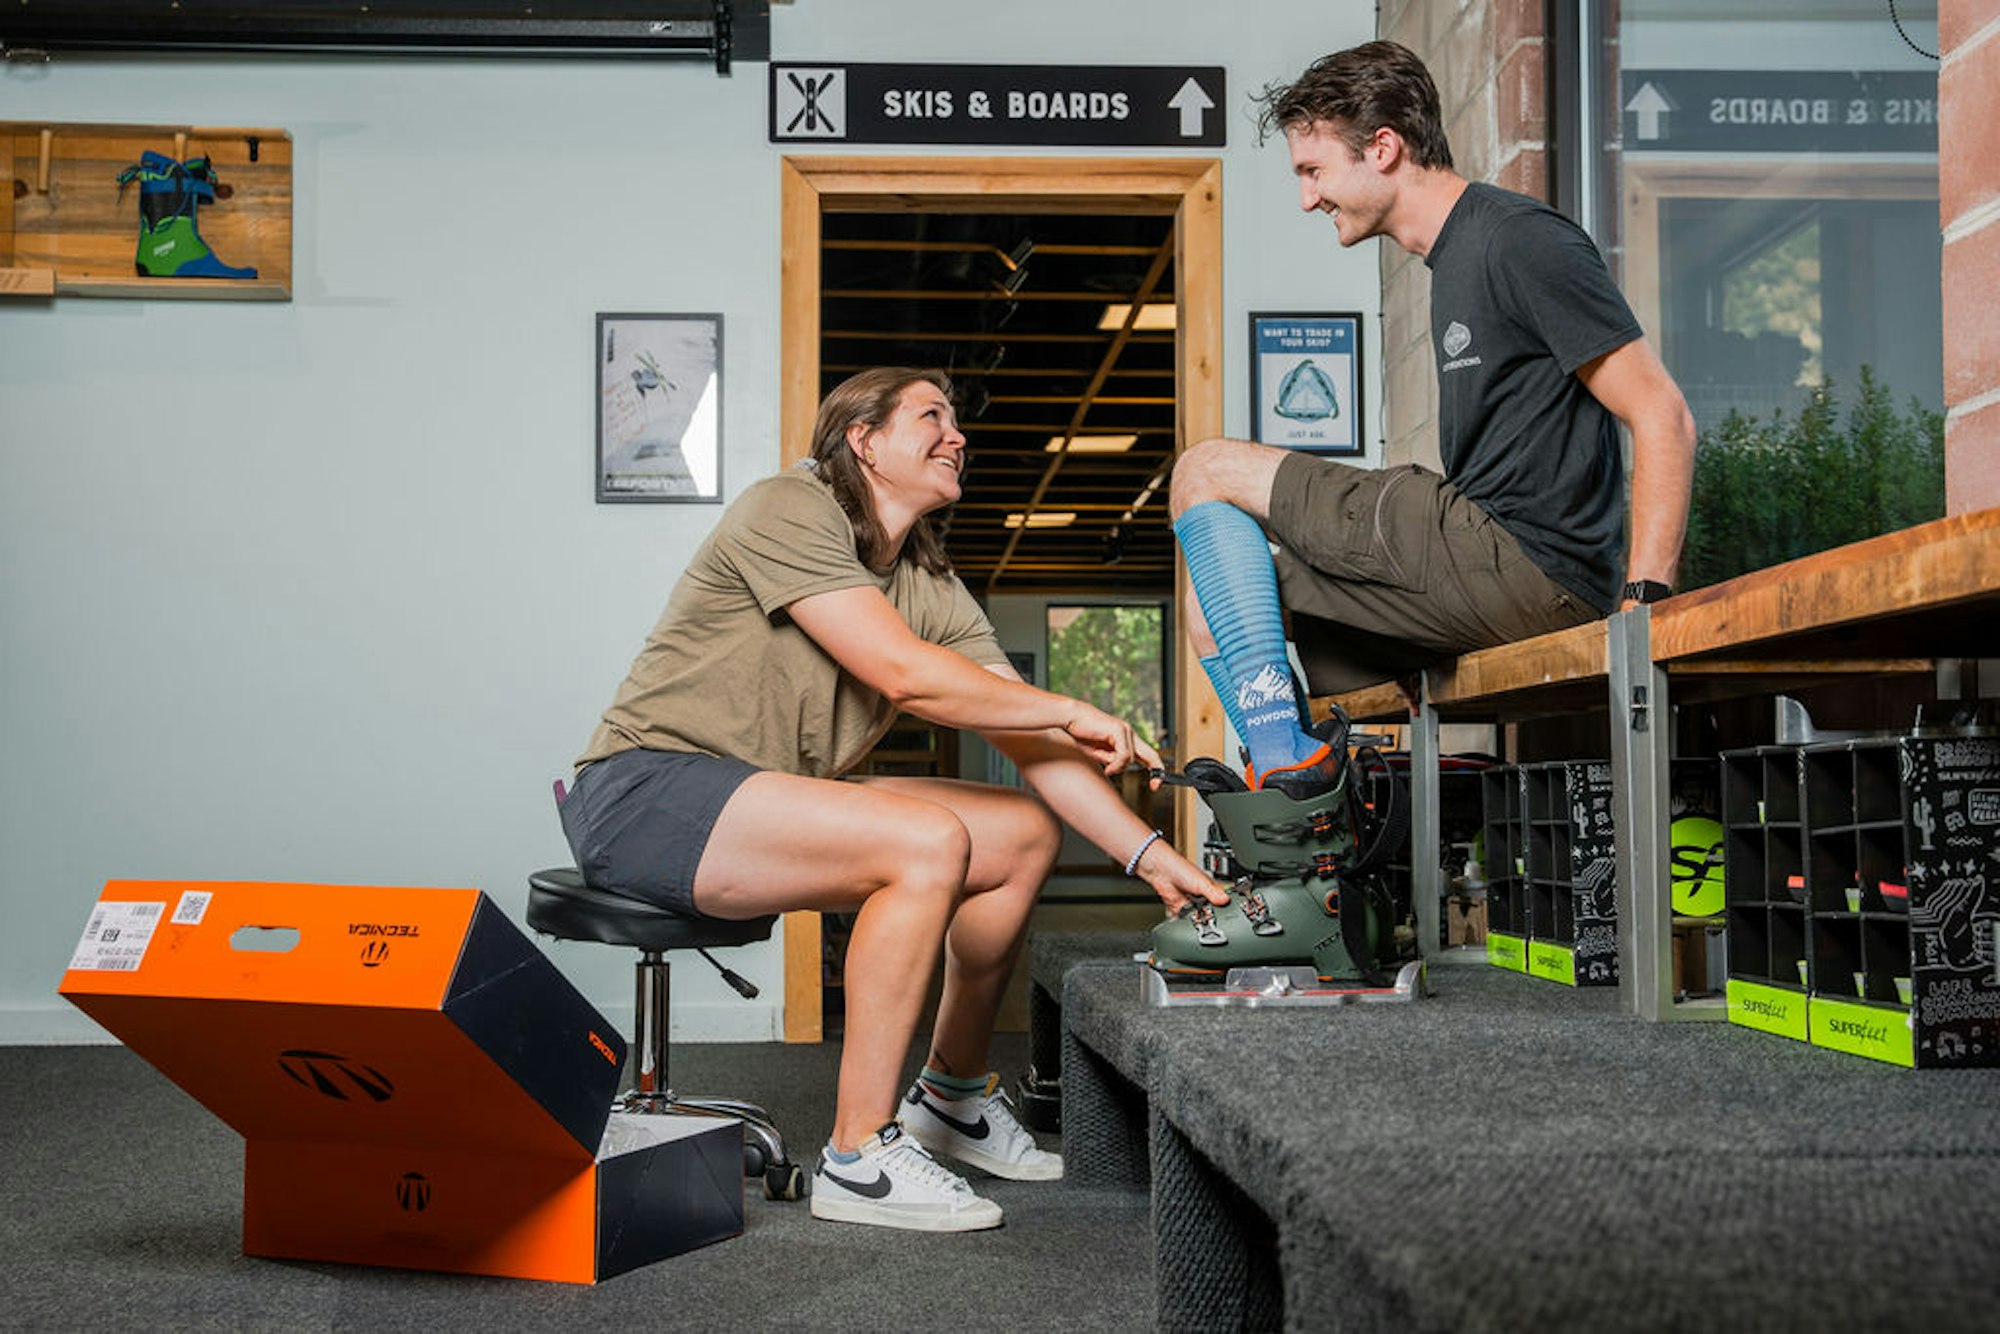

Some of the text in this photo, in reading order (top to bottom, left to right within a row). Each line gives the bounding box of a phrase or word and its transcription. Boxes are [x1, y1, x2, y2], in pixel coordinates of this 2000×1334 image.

[883, 90, 1130, 120] SKIS & BOARDS
[1263, 327, 1345, 337] WANT TO TRADE IN
[1280, 338, 1331, 347] YOUR SKIS?
[349, 923, 419, 937] TECNICA
